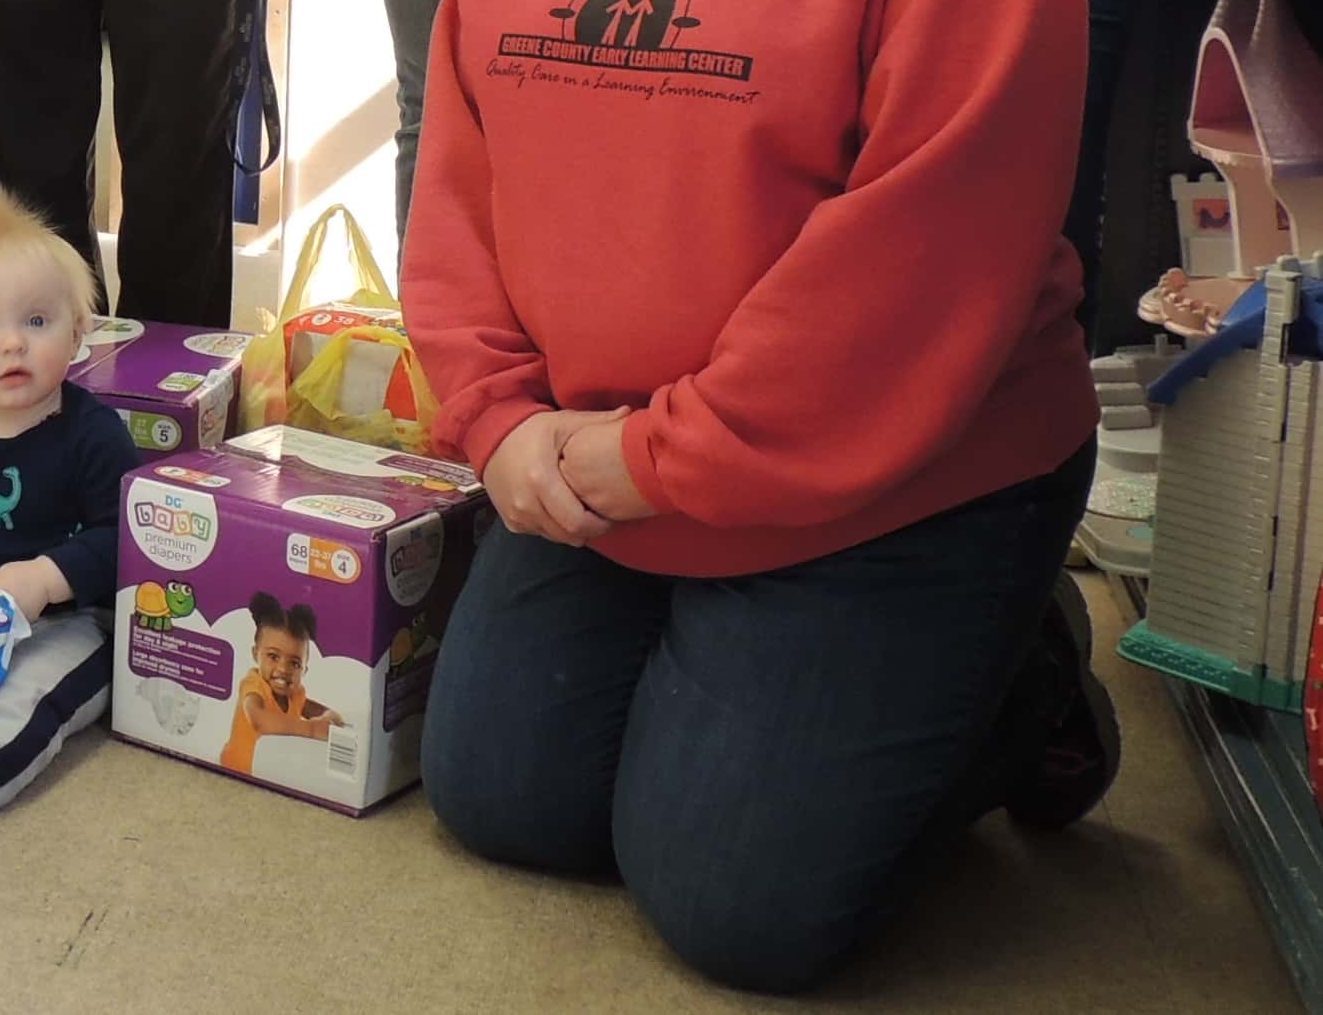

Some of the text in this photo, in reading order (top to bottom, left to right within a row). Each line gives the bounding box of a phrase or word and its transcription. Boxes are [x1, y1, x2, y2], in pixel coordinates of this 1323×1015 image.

[502, 37, 746, 76] GREENE COUNTY EARLY LEARNING CENTER
[486, 58, 761, 105] Quality Care in a Learning Environment
[160, 429, 168, 442] 5
[165, 494, 182, 509] DG
[135, 503, 210, 541] baby
[144, 532, 197, 555] premium
[149, 543, 192, 566] diapers
[291, 543, 308, 559] 68
[338, 560, 347, 574] 4
